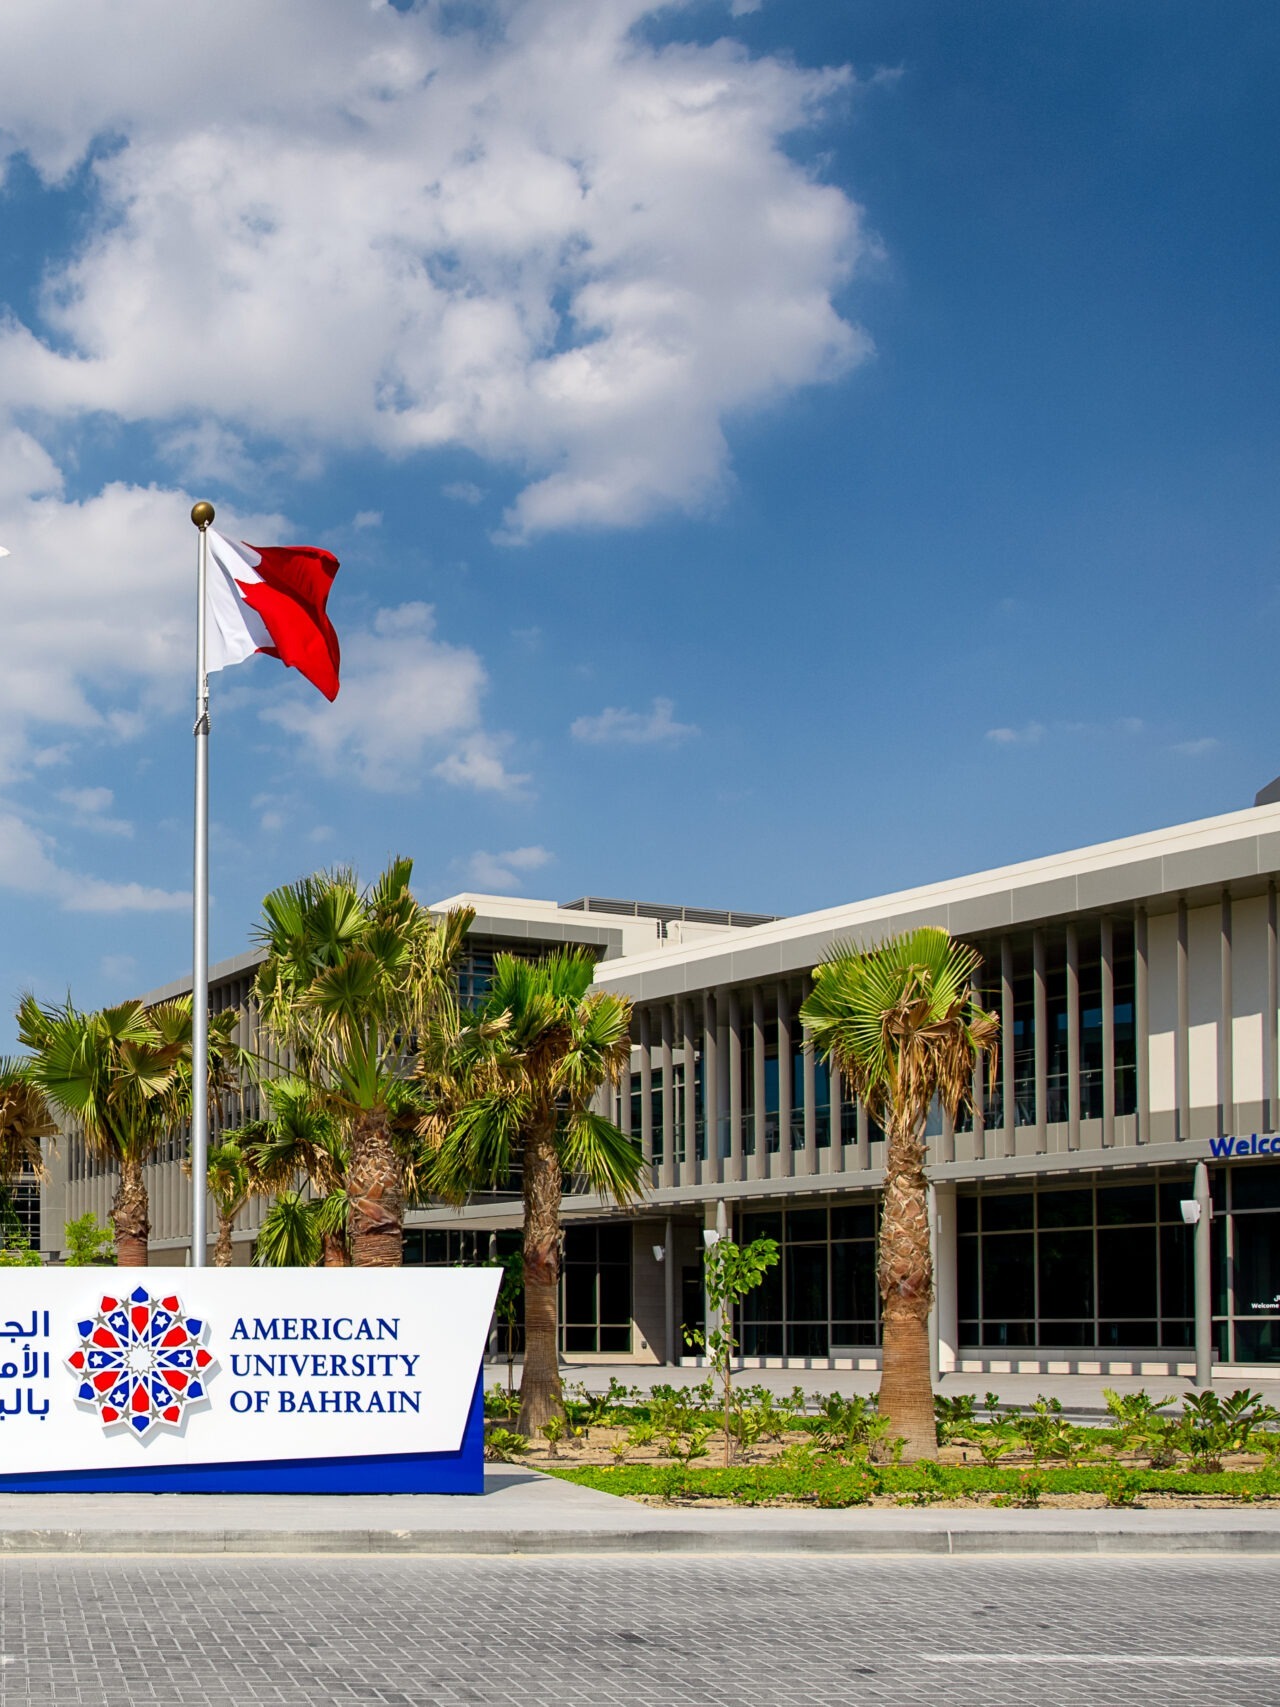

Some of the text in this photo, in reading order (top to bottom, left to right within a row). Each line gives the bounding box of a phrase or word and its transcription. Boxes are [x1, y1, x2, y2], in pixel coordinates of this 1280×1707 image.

[230, 1317, 400, 1341] AMERICAN
[230, 1354, 421, 1378] UNIVERSITY
[229, 1390, 422, 1414] OF BAHRAIN
